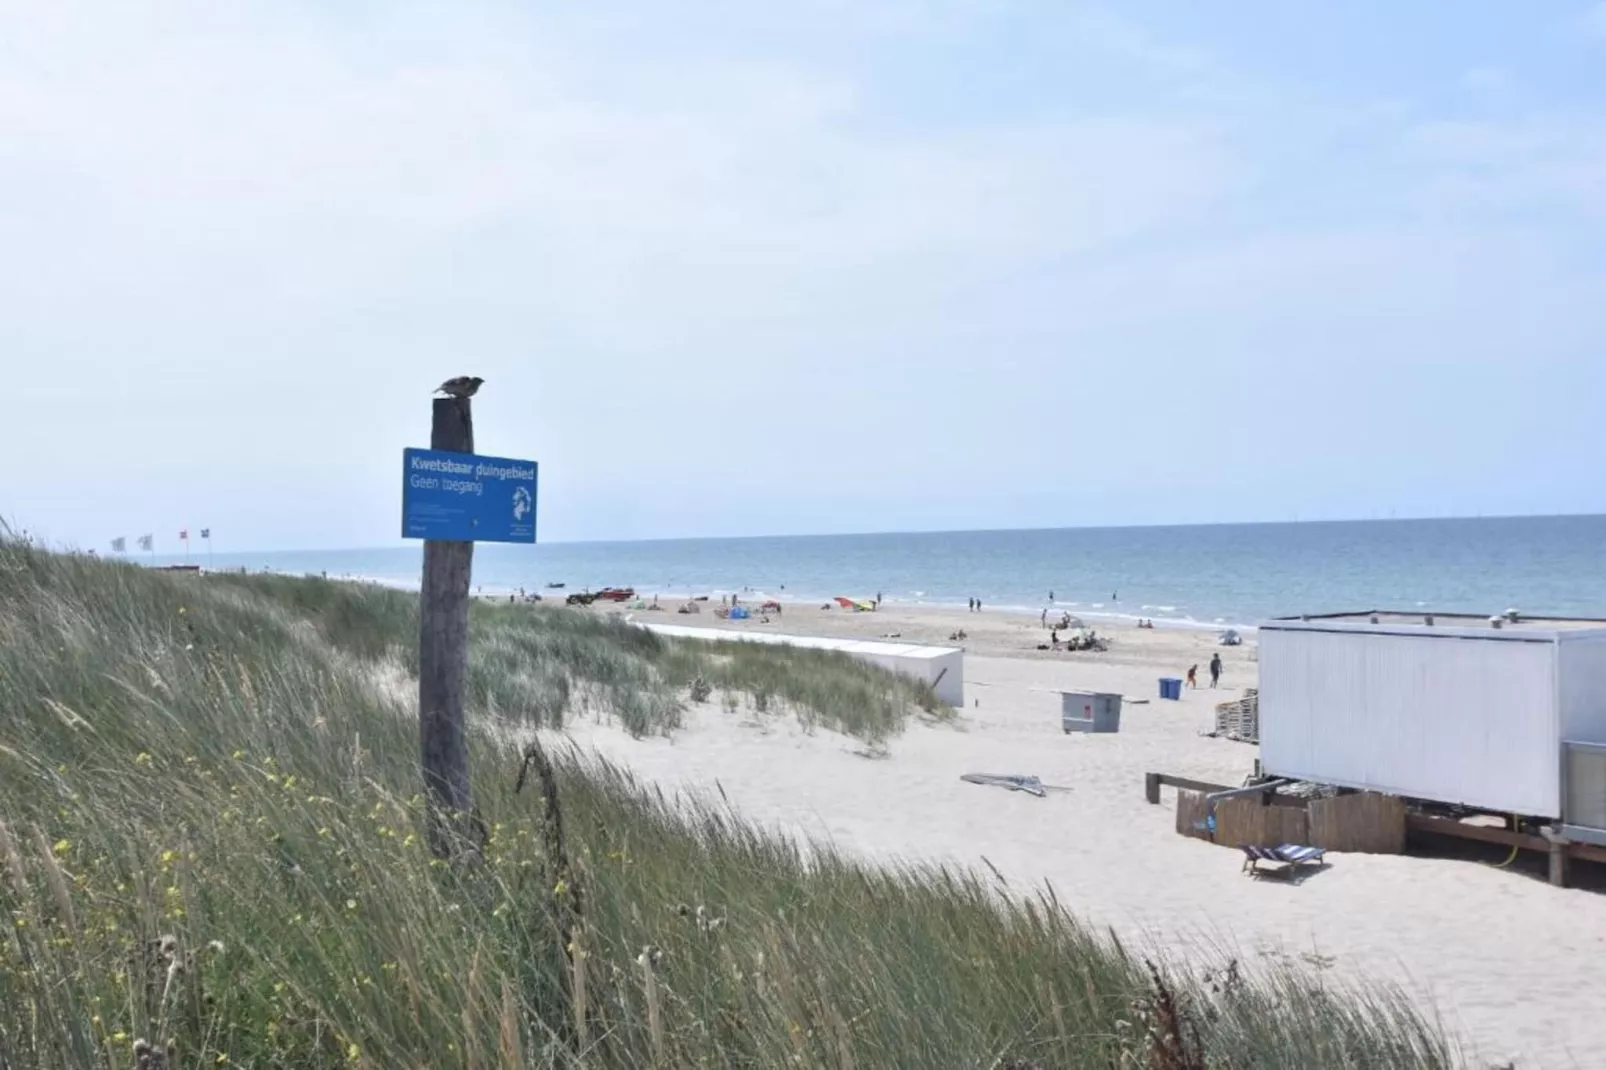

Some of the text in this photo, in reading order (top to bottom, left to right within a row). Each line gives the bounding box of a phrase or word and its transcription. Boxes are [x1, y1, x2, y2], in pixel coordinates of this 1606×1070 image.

[411, 456, 534, 480] Kwetsbaar duingebied
[410, 474, 483, 496] Geen toegang
